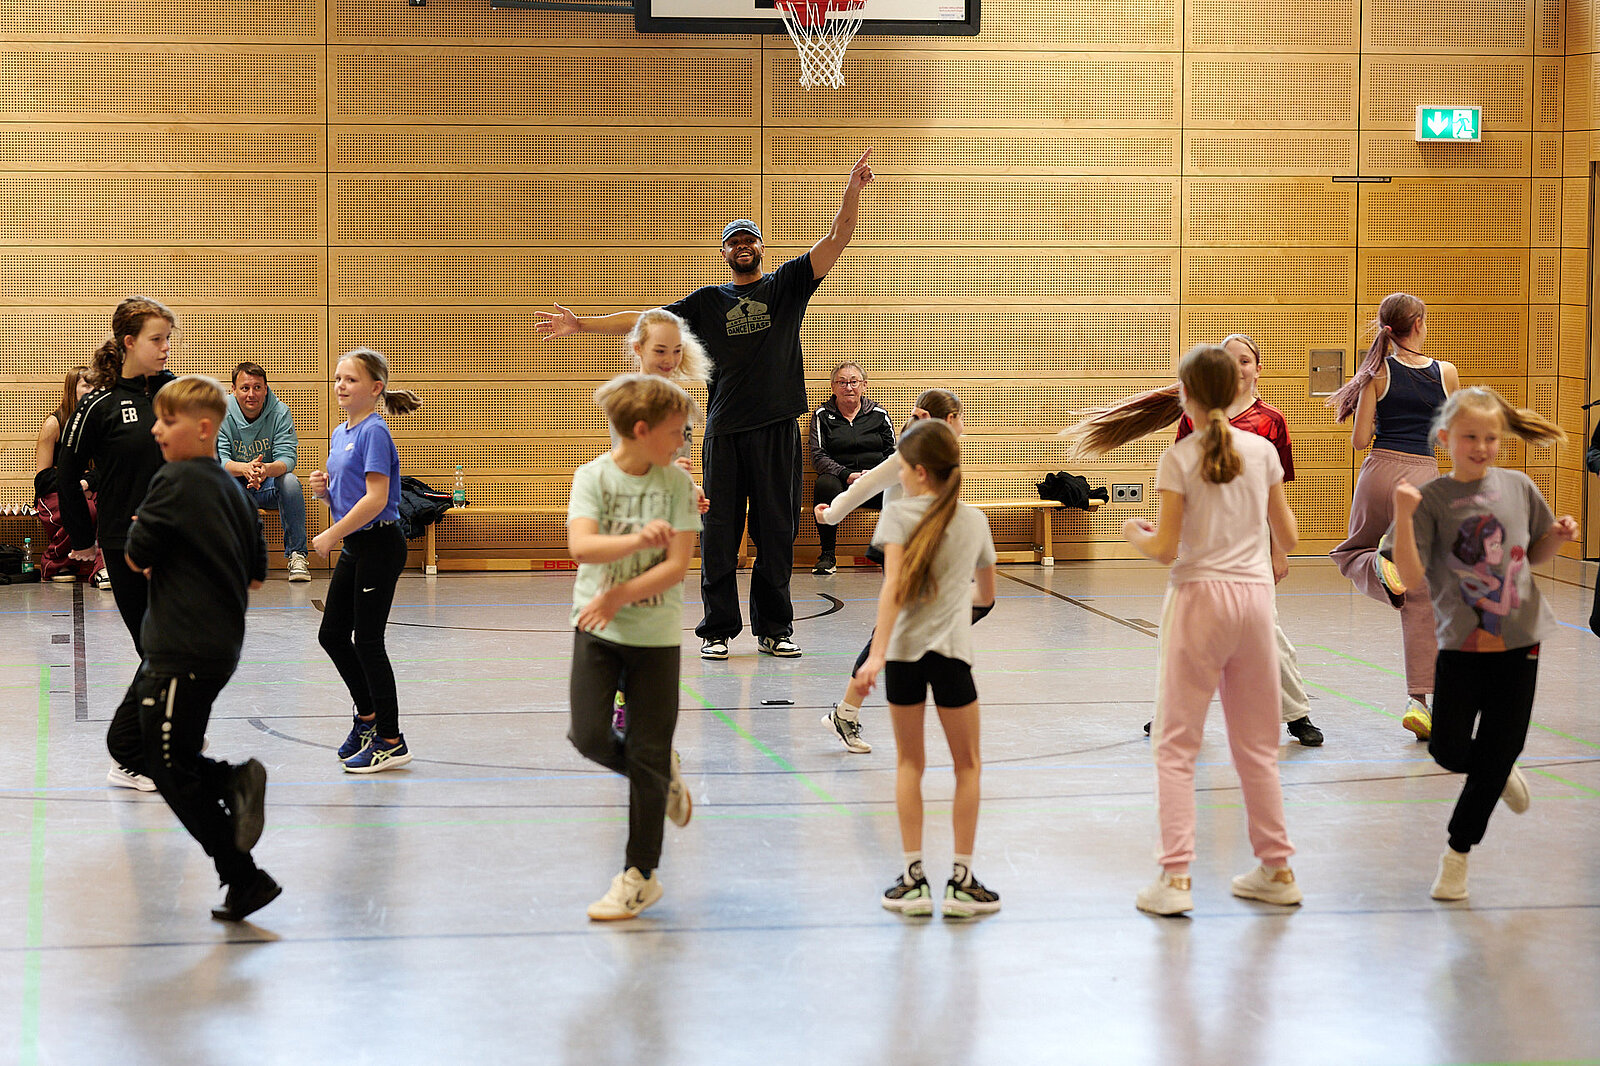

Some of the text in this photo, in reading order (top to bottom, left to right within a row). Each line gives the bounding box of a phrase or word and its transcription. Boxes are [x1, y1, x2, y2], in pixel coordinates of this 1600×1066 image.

[728, 323, 748, 334] DANCE
[750, 321, 770, 331] BASE
[122, 407, 138, 423] EB
